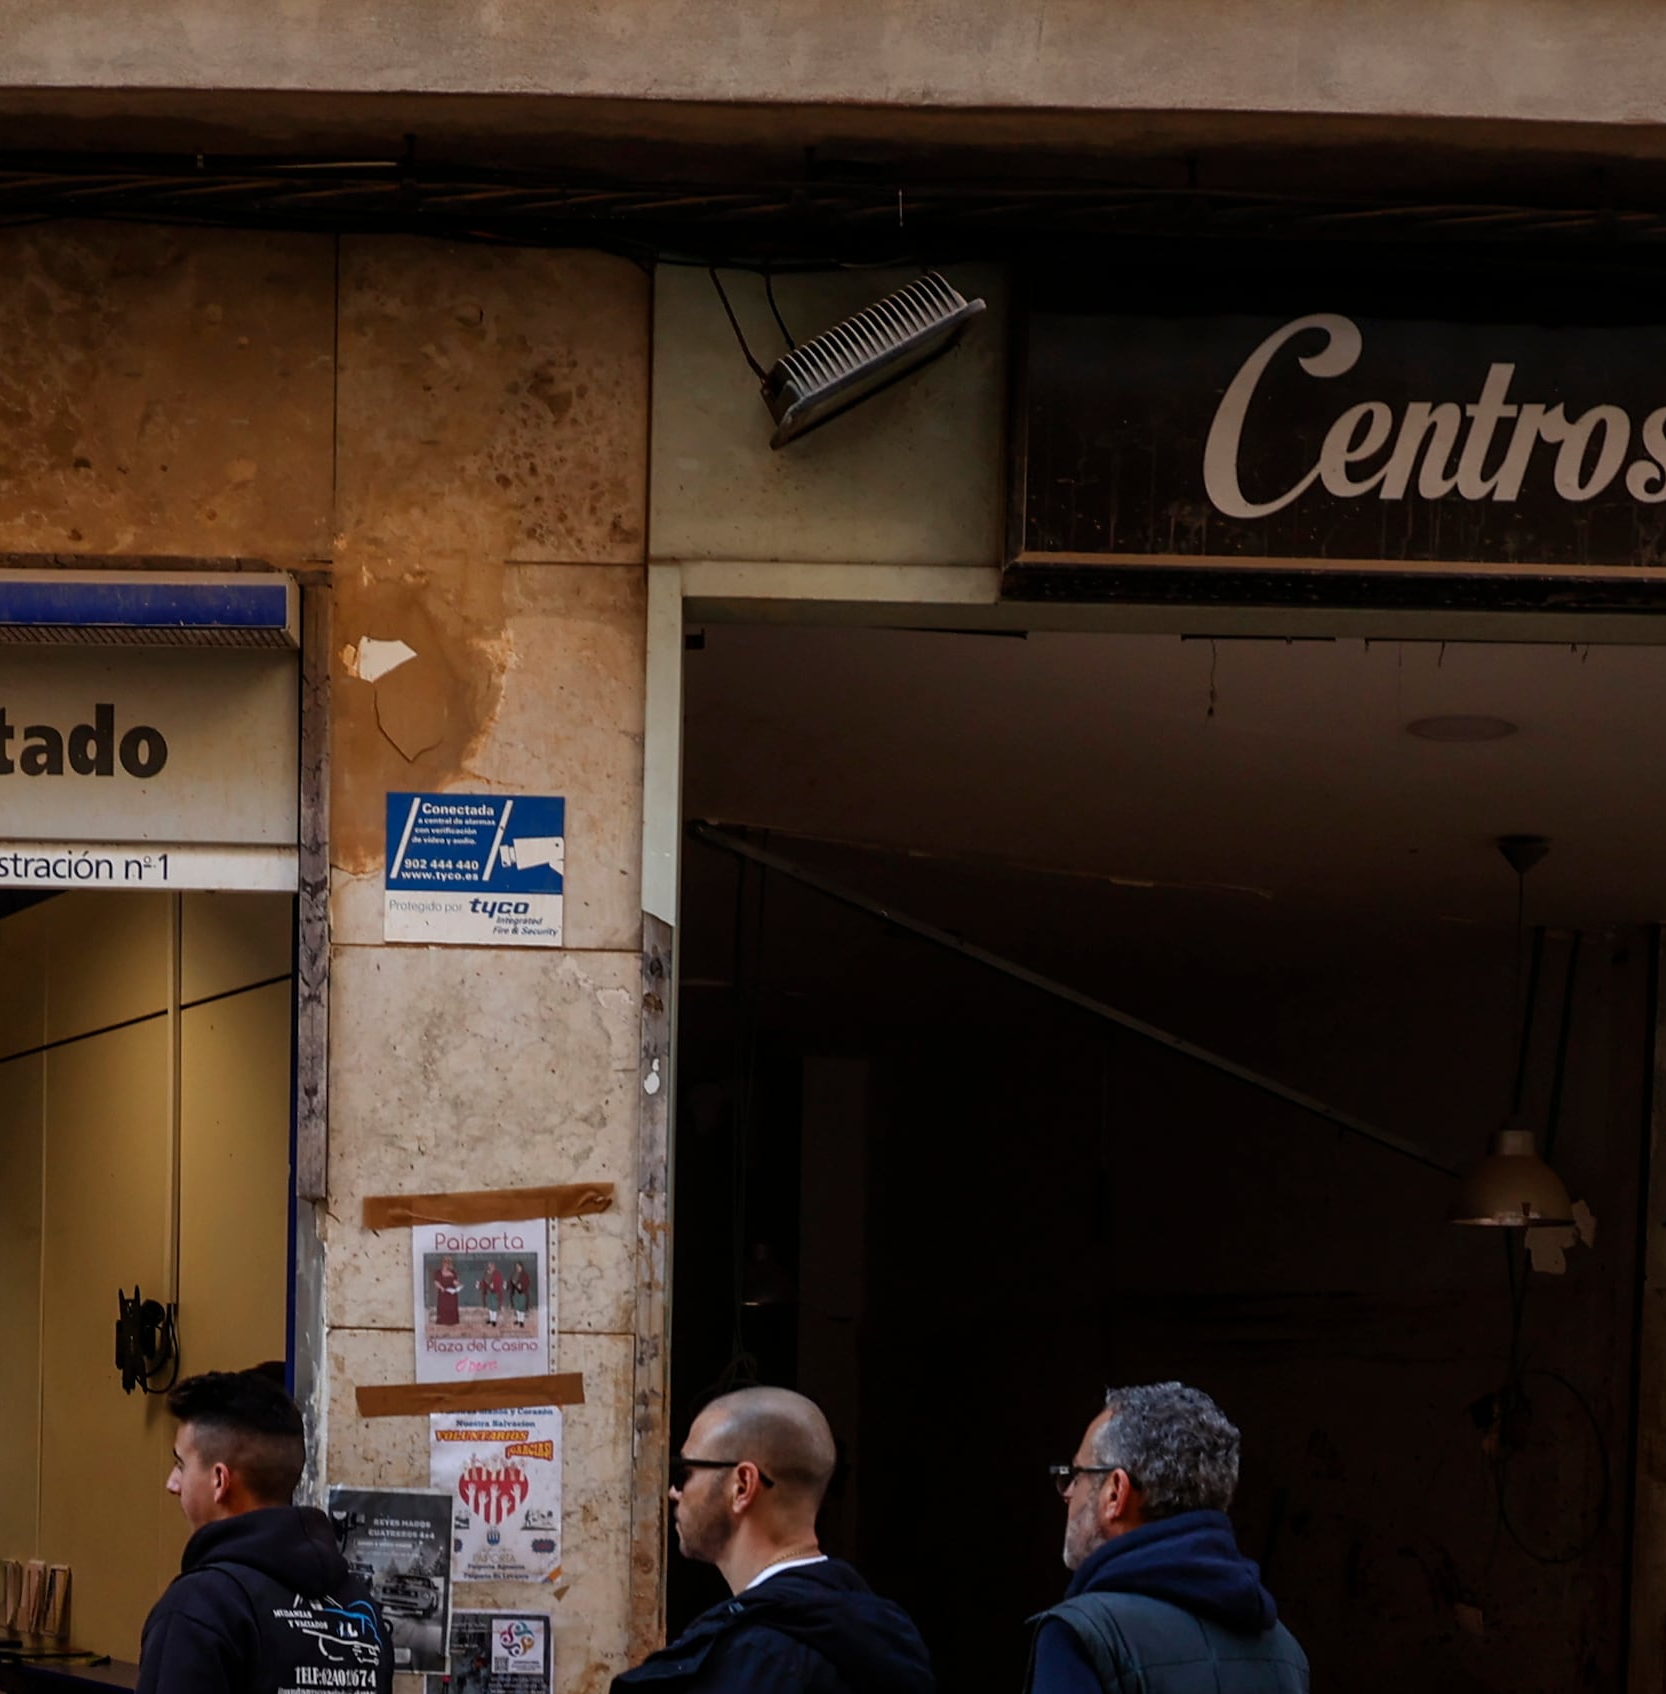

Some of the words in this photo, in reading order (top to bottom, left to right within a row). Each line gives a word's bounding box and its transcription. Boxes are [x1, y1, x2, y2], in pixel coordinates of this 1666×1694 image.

[421, 802, 495, 816] Conectada
[404, 858, 427, 869] 902
[430, 859, 454, 870] 444
[455, 859, 480, 871] 440
[401, 870, 479, 882] www.tyco.es
[389, 900, 443, 913] Protegido
[444, 903, 462, 914] por
[469, 897, 530, 919] tyco
[496, 916, 543, 927] Integrated
[493, 926, 510, 935] Fire
[511, 927, 520, 935] &
[520, 927, 557, 937] Security
[434, 1231, 525, 1255] Paiporta
[426, 1339, 464, 1353] Plaza
[467, 1339, 488, 1353] del
[491, 1338, 539, 1353] Casino
